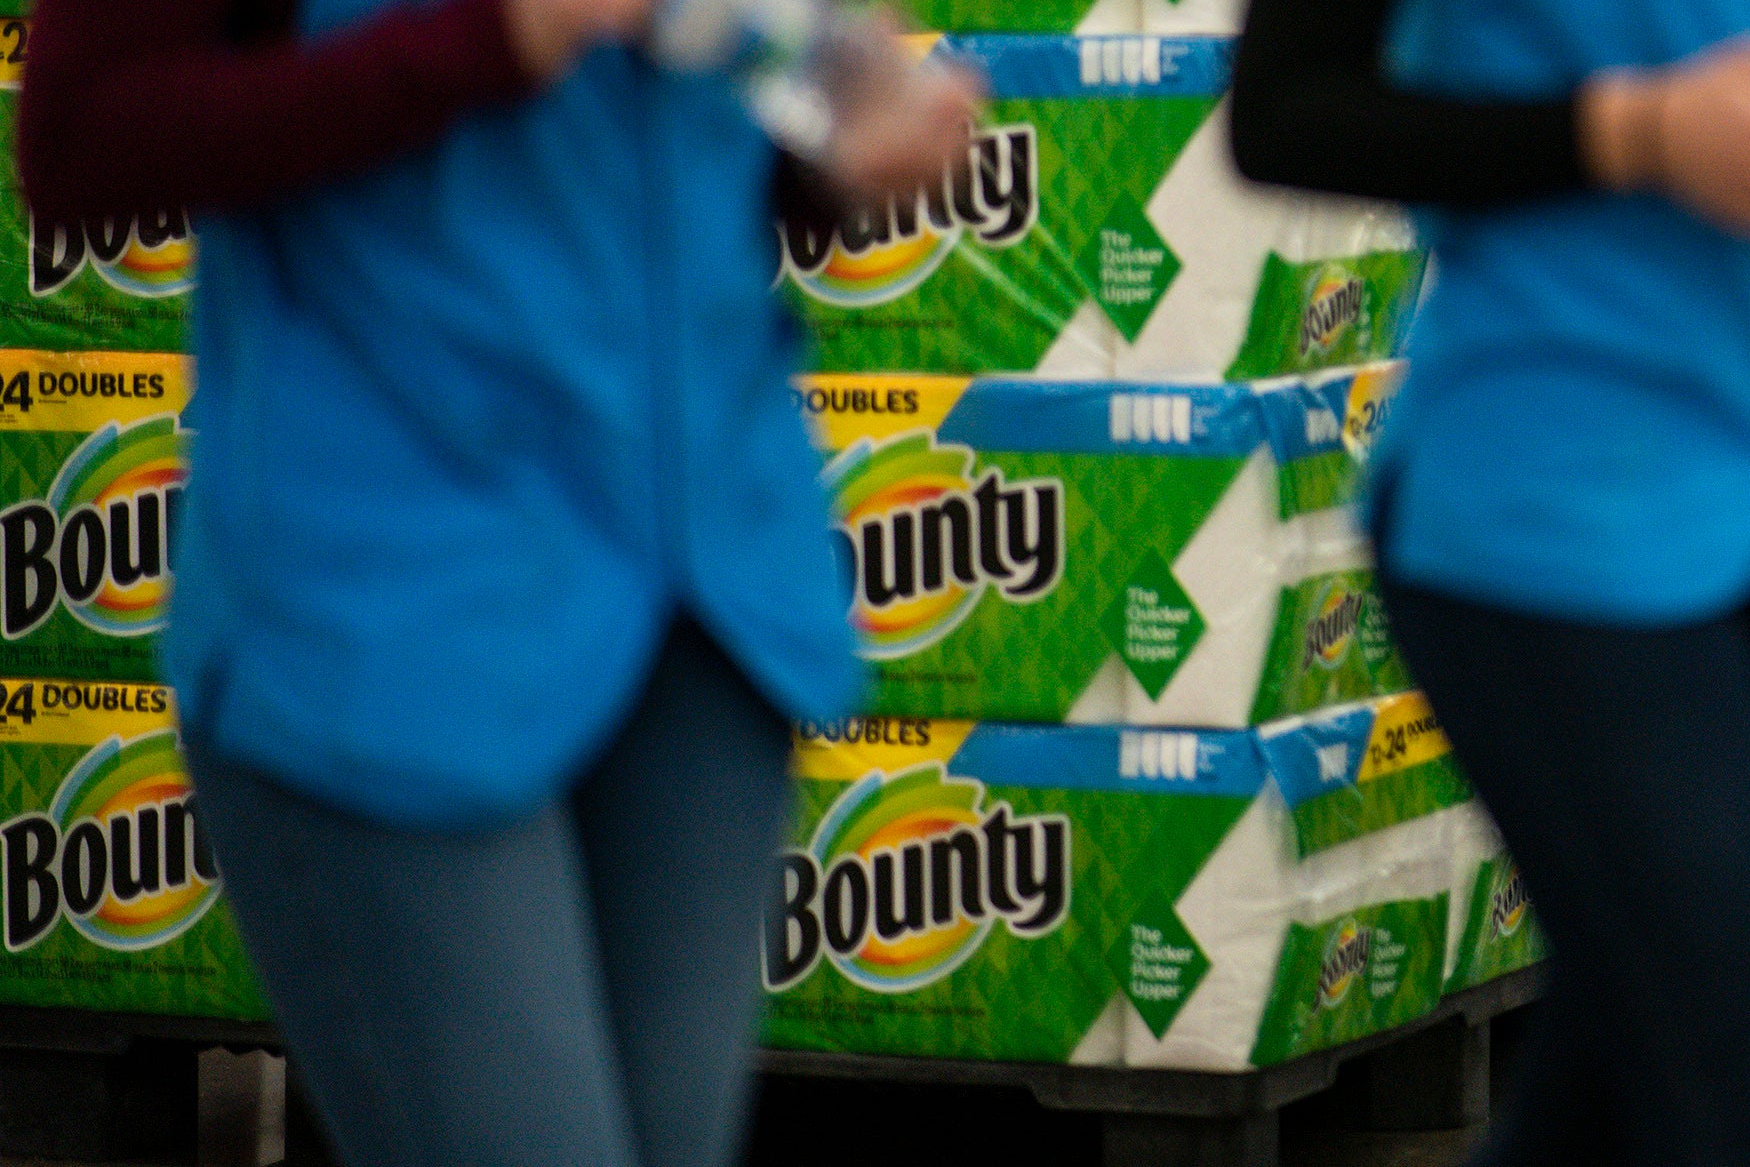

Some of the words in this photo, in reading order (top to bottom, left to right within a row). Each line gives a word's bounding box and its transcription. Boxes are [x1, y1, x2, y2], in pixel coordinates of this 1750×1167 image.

[39, 371, 165, 398] DOUBLES
[42, 684, 167, 713] DOUBLES
[767, 808, 1064, 984] Bounty
